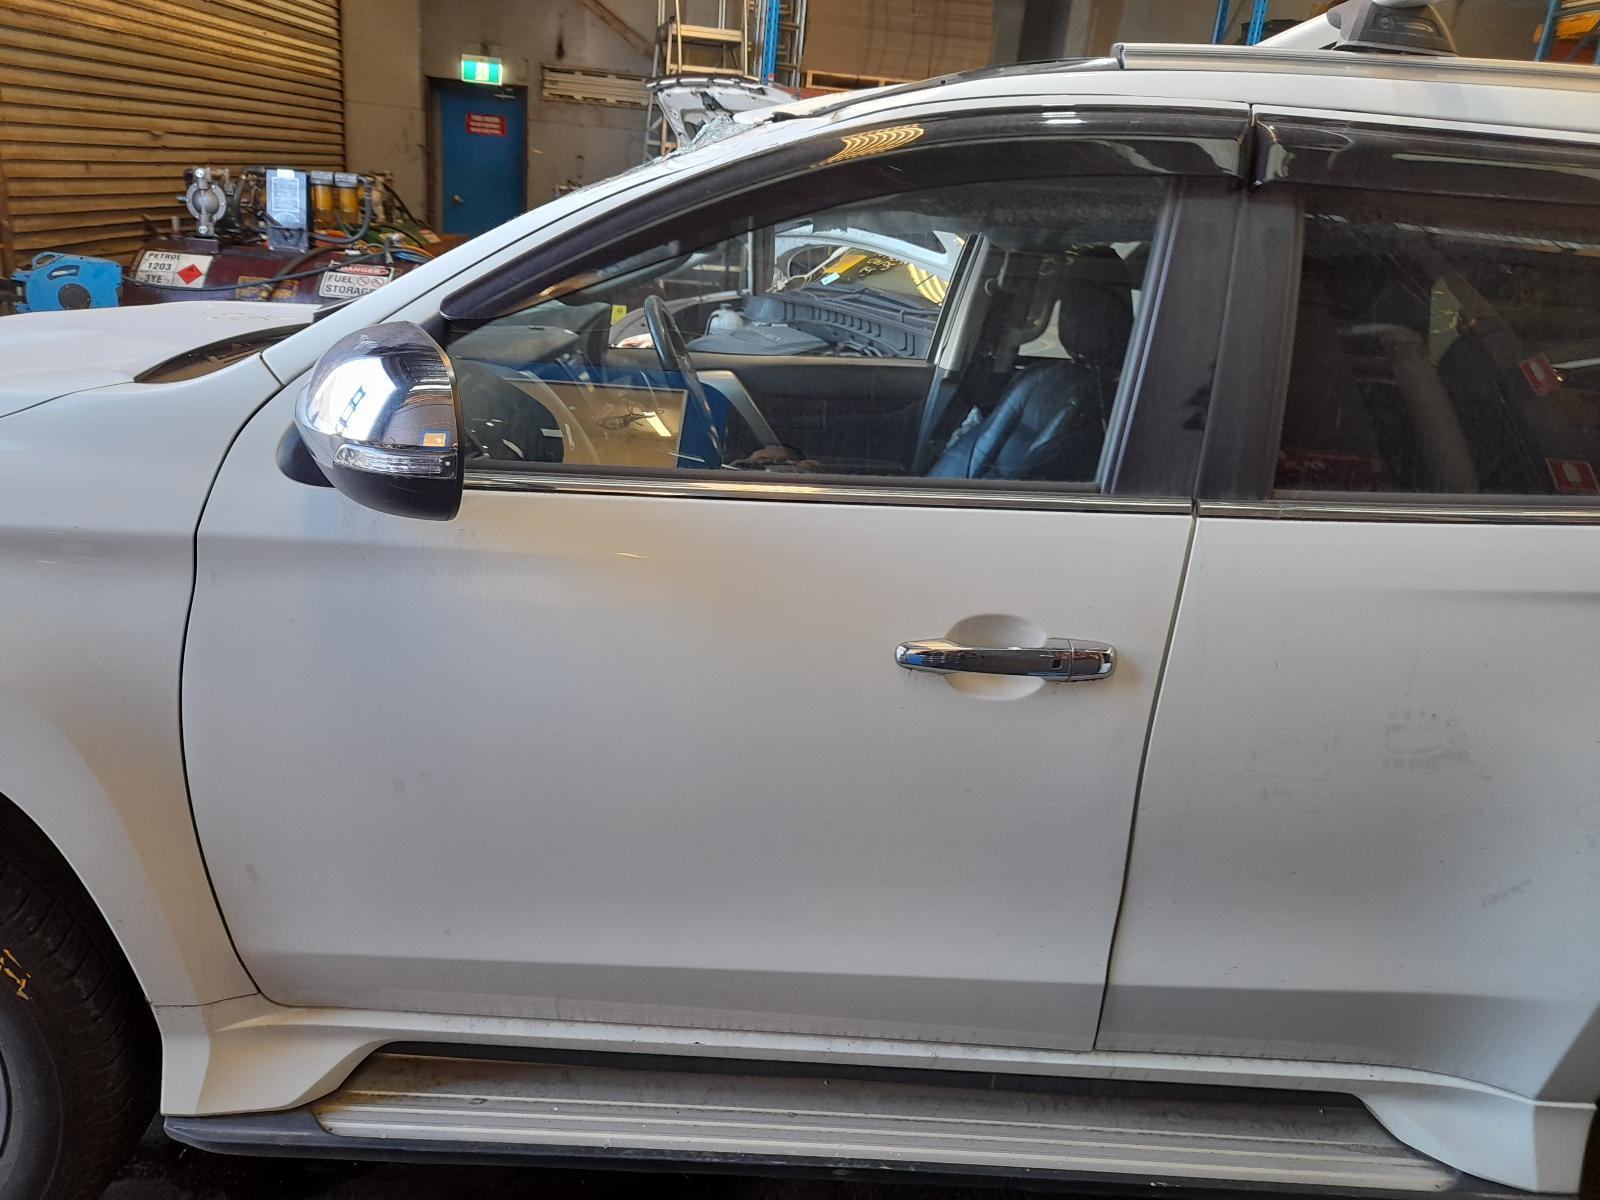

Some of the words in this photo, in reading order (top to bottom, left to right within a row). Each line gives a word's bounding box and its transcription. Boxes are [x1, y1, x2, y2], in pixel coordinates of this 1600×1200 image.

[147, 252, 182, 260] PETROL
[147, 262, 172, 271] 1203
[328, 274, 353, 284] FUEL
